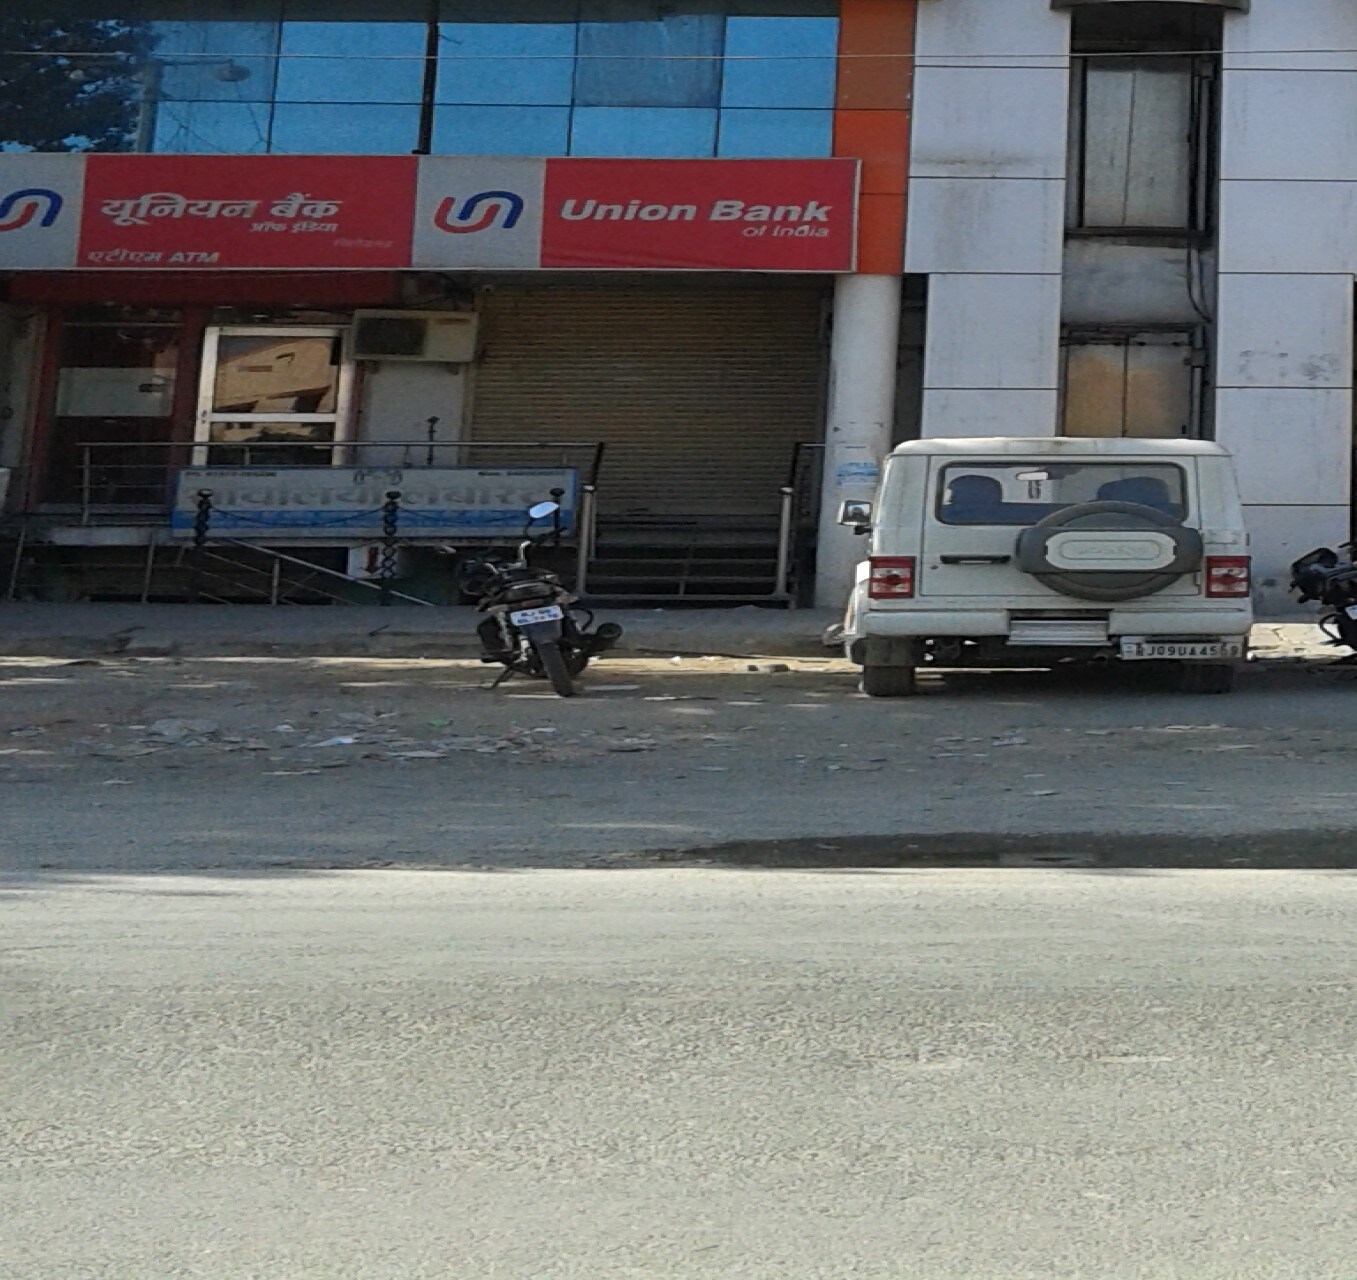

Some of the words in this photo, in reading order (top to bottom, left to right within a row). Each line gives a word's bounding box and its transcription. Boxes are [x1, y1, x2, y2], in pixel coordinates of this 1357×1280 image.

[101, 193, 261, 225] यूनियन
[270, 192, 342, 218] बैंक
[561, 199, 697, 221] Union
[710, 200, 832, 222] Bank
[742, 225, 767, 237] of
[772, 225, 829, 237] India
[169, 251, 220, 263] ATM
